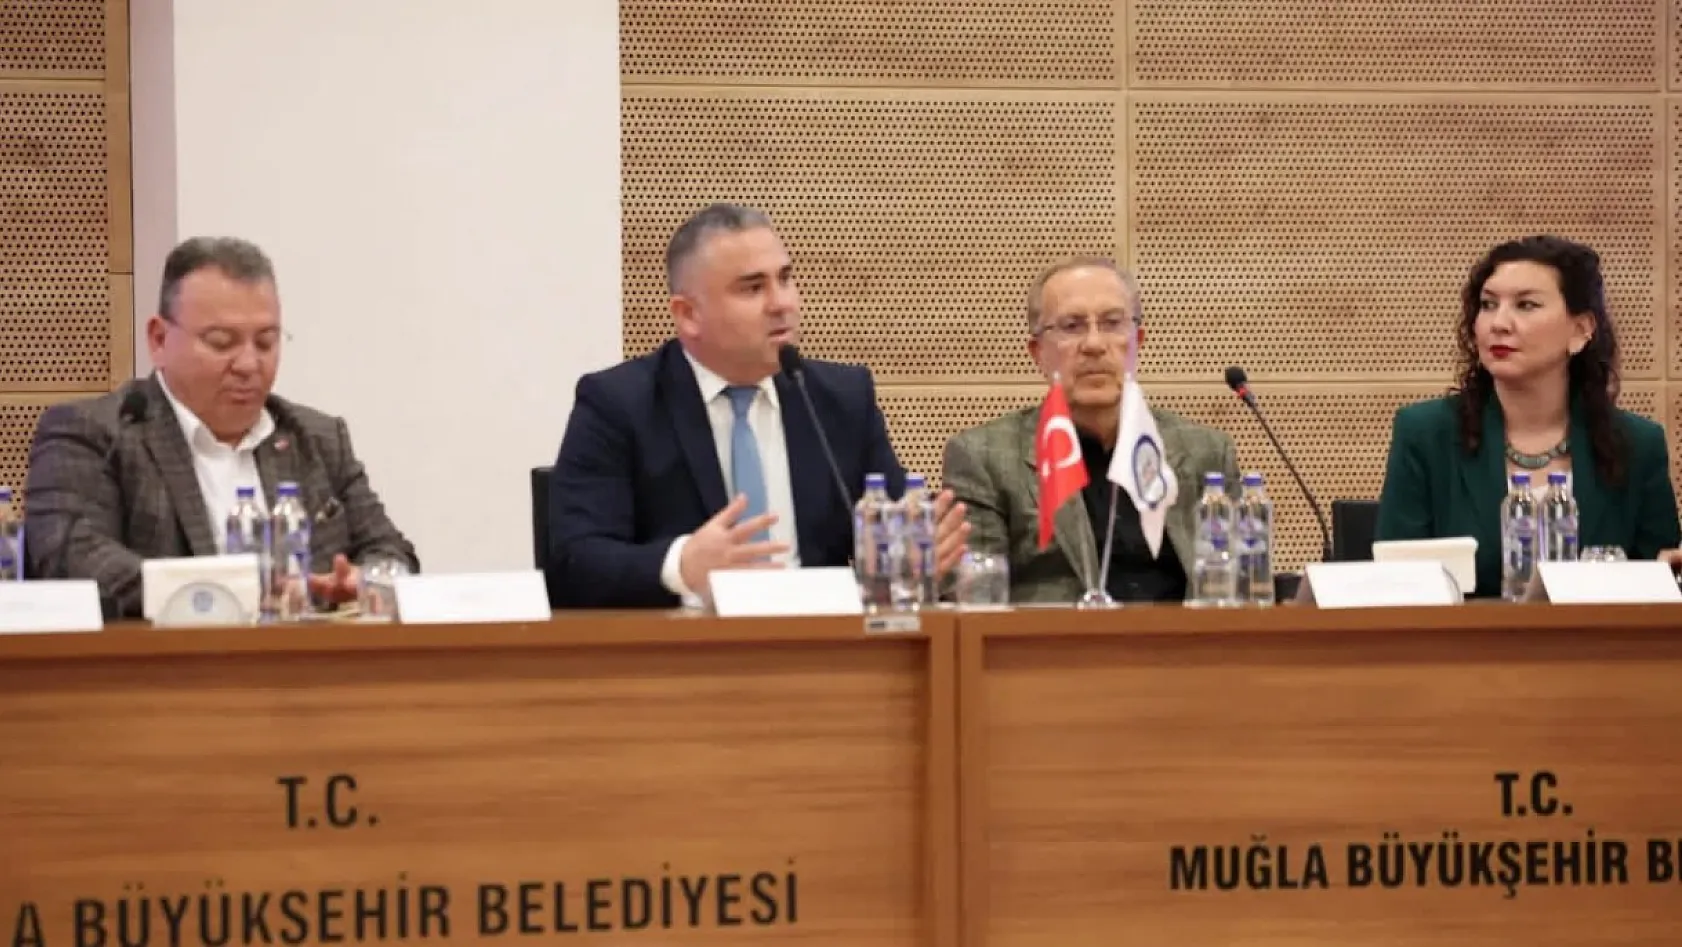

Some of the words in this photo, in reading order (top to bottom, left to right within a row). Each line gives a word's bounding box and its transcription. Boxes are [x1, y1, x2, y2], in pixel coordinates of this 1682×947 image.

[277, 774, 378, 829] T.C.
[1494, 771, 1574, 817] T.C.
[1169, 834, 1330, 890] MUĞLA
[1347, 828, 1630, 899] BÜYÜKŞEHİR
[477, 859, 798, 936] BELEDİYESİ
